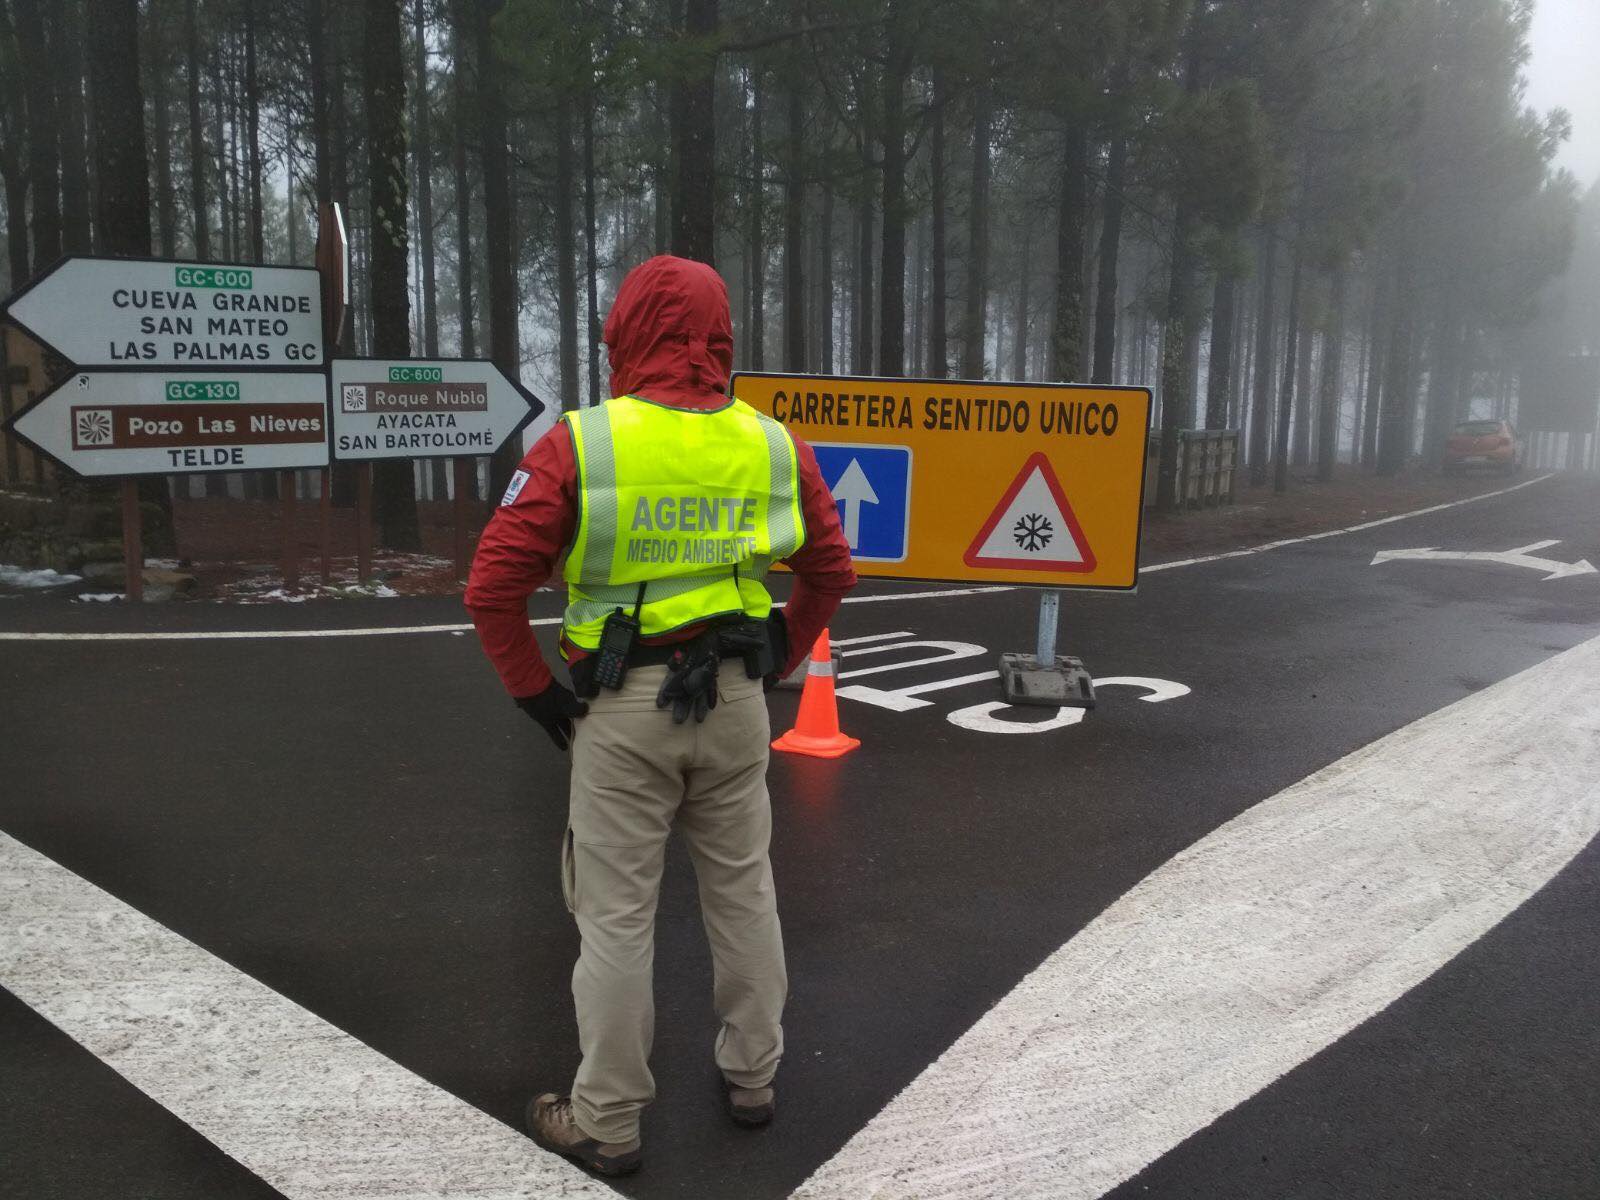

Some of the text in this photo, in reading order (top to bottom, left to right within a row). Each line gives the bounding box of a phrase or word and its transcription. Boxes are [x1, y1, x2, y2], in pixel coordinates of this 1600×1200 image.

[178, 269, 250, 287] GC-600
[112, 289, 311, 313] CUEVA GRANDE
[140, 317, 288, 336] SAN MATEO
[110, 342, 316, 360] LAS PALMAS GC
[390, 368, 441, 381] GC-600
[168, 383, 238, 399] GC-130
[375, 391, 429, 408] Roque
[376, 414, 457, 429] AYACATA
[772, 391, 1119, 437] CARRETERA SENTIDO UNICO
[128, 415, 321, 436] Pozo Las Nieves
[338, 429, 493, 450] SAN BARTOLOMÉ
[167, 448, 244, 467] TELDE
[631, 496, 757, 531] AGENTE
[626, 536, 757, 563] MEDIO AMBIENTE
